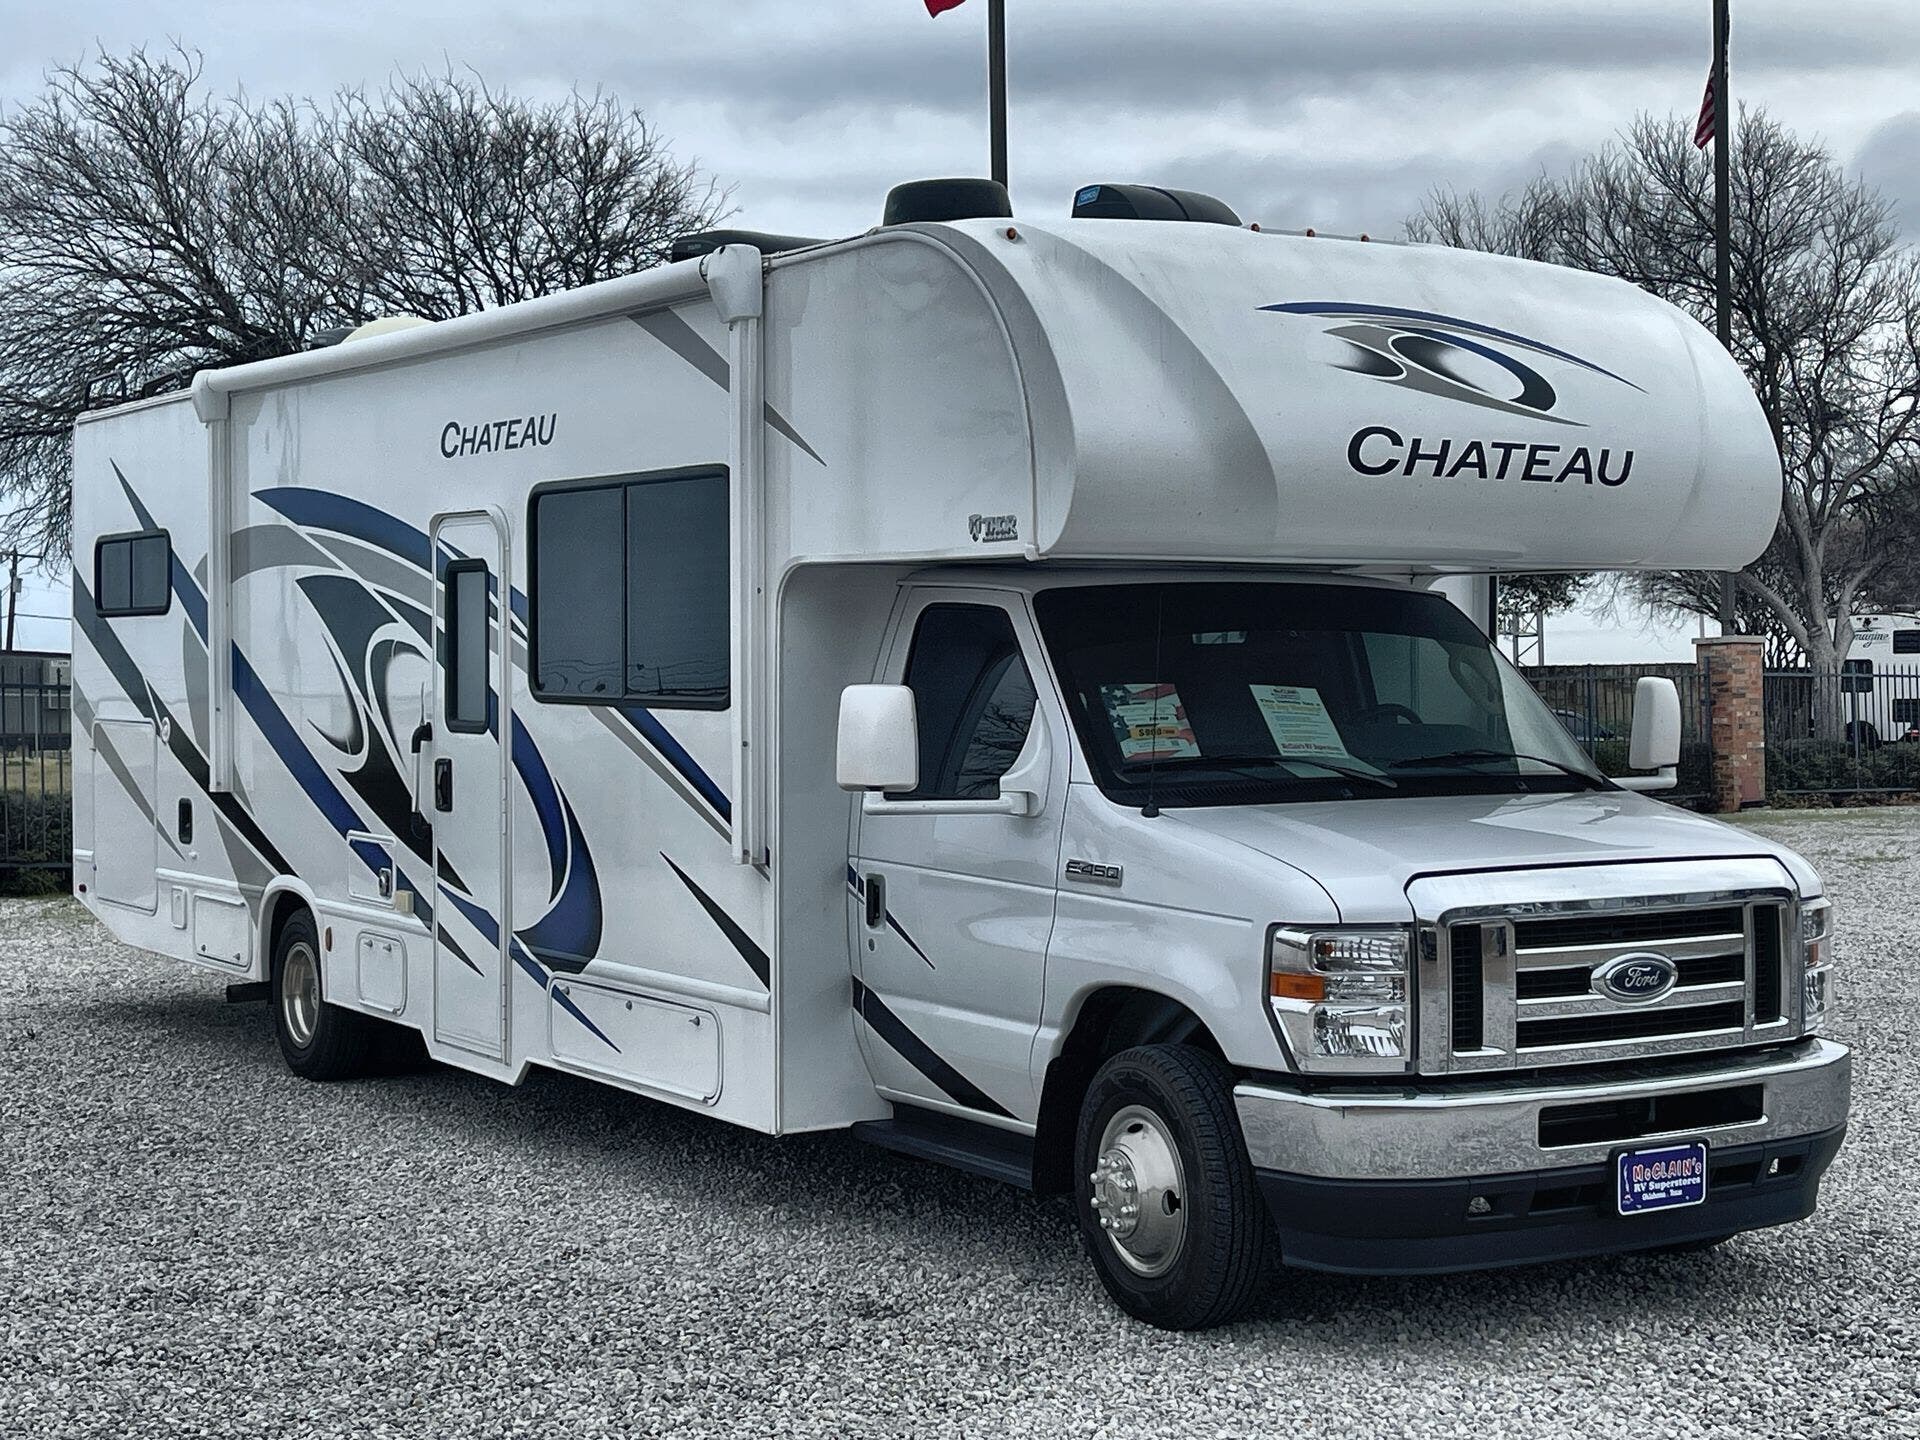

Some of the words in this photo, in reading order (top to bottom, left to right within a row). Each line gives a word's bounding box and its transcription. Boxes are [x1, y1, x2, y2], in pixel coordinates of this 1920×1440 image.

[440, 413, 557, 459] CHATEAU
[1347, 426, 1634, 486] CHATEAU
[1855, 632, 1889, 648] magine
[1624, 966, 1661, 988] Ford
[1633, 1182, 1648, 1192] RV
[1648, 1176, 1701, 1191] Superstores
